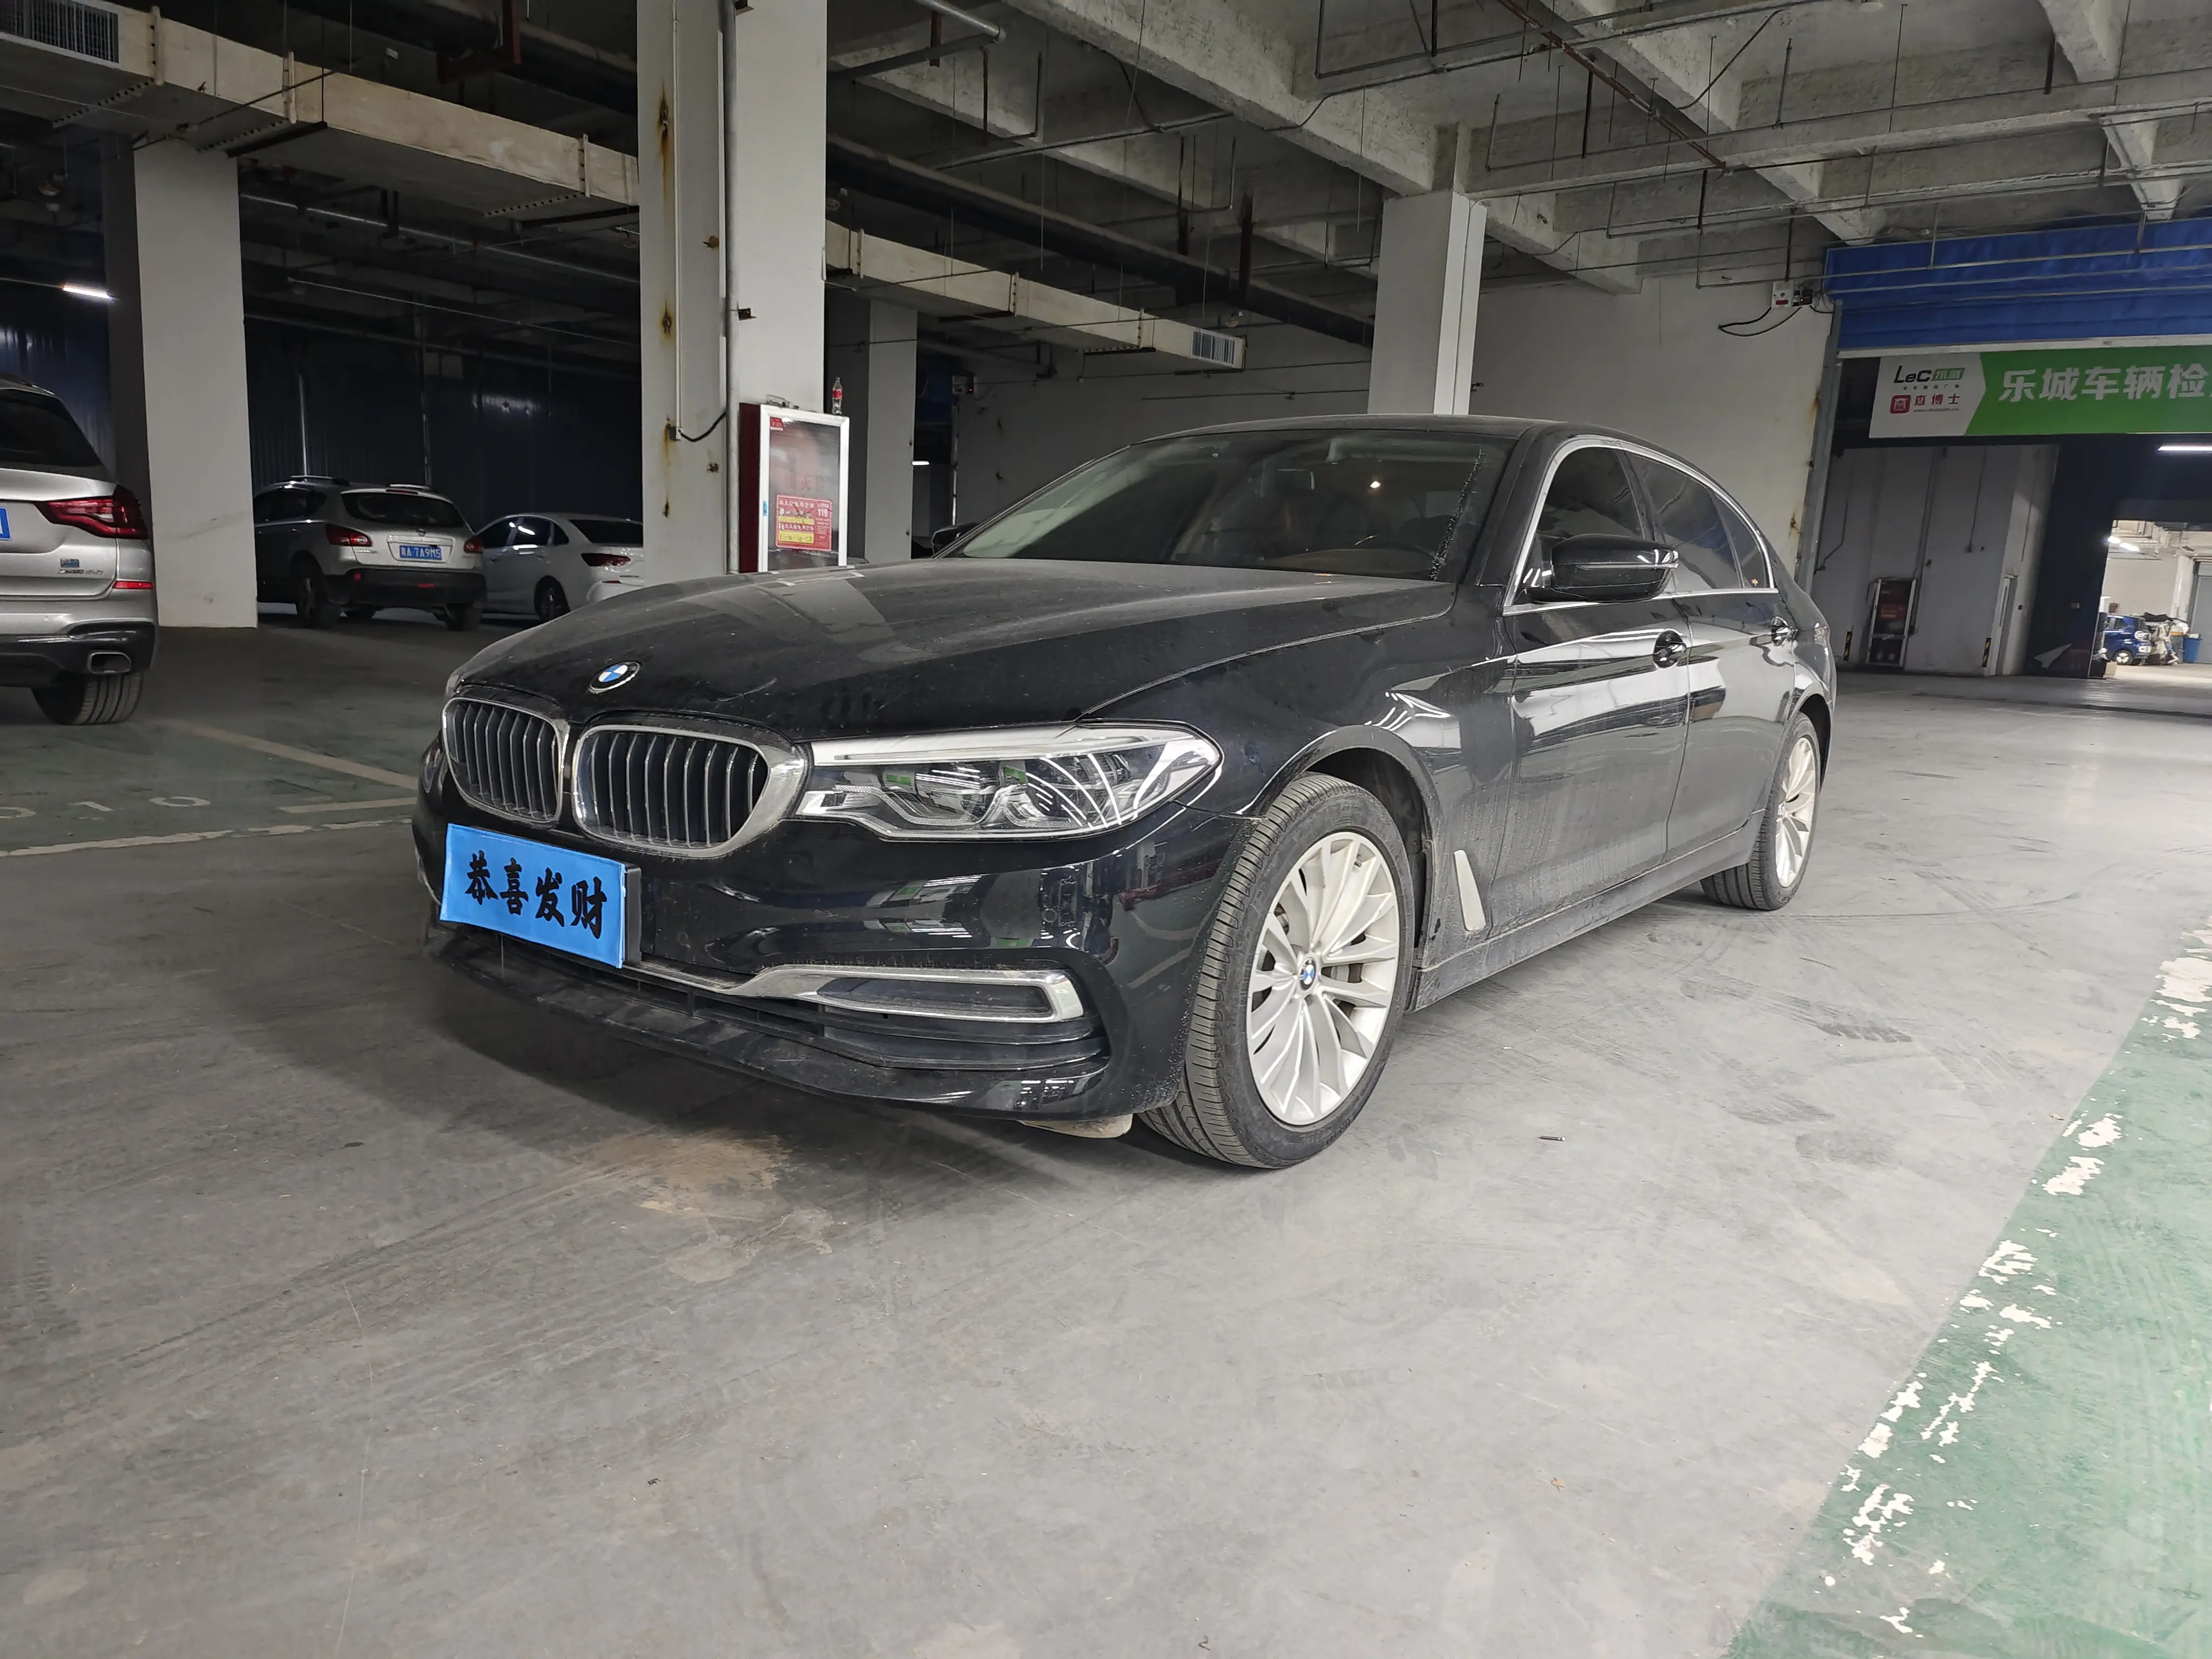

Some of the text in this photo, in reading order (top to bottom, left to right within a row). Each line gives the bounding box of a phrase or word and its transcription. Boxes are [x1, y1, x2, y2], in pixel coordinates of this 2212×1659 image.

[1999, 363, 2212, 402] 乐城车辆检
[464, 849, 608, 940] 恭喜发财
